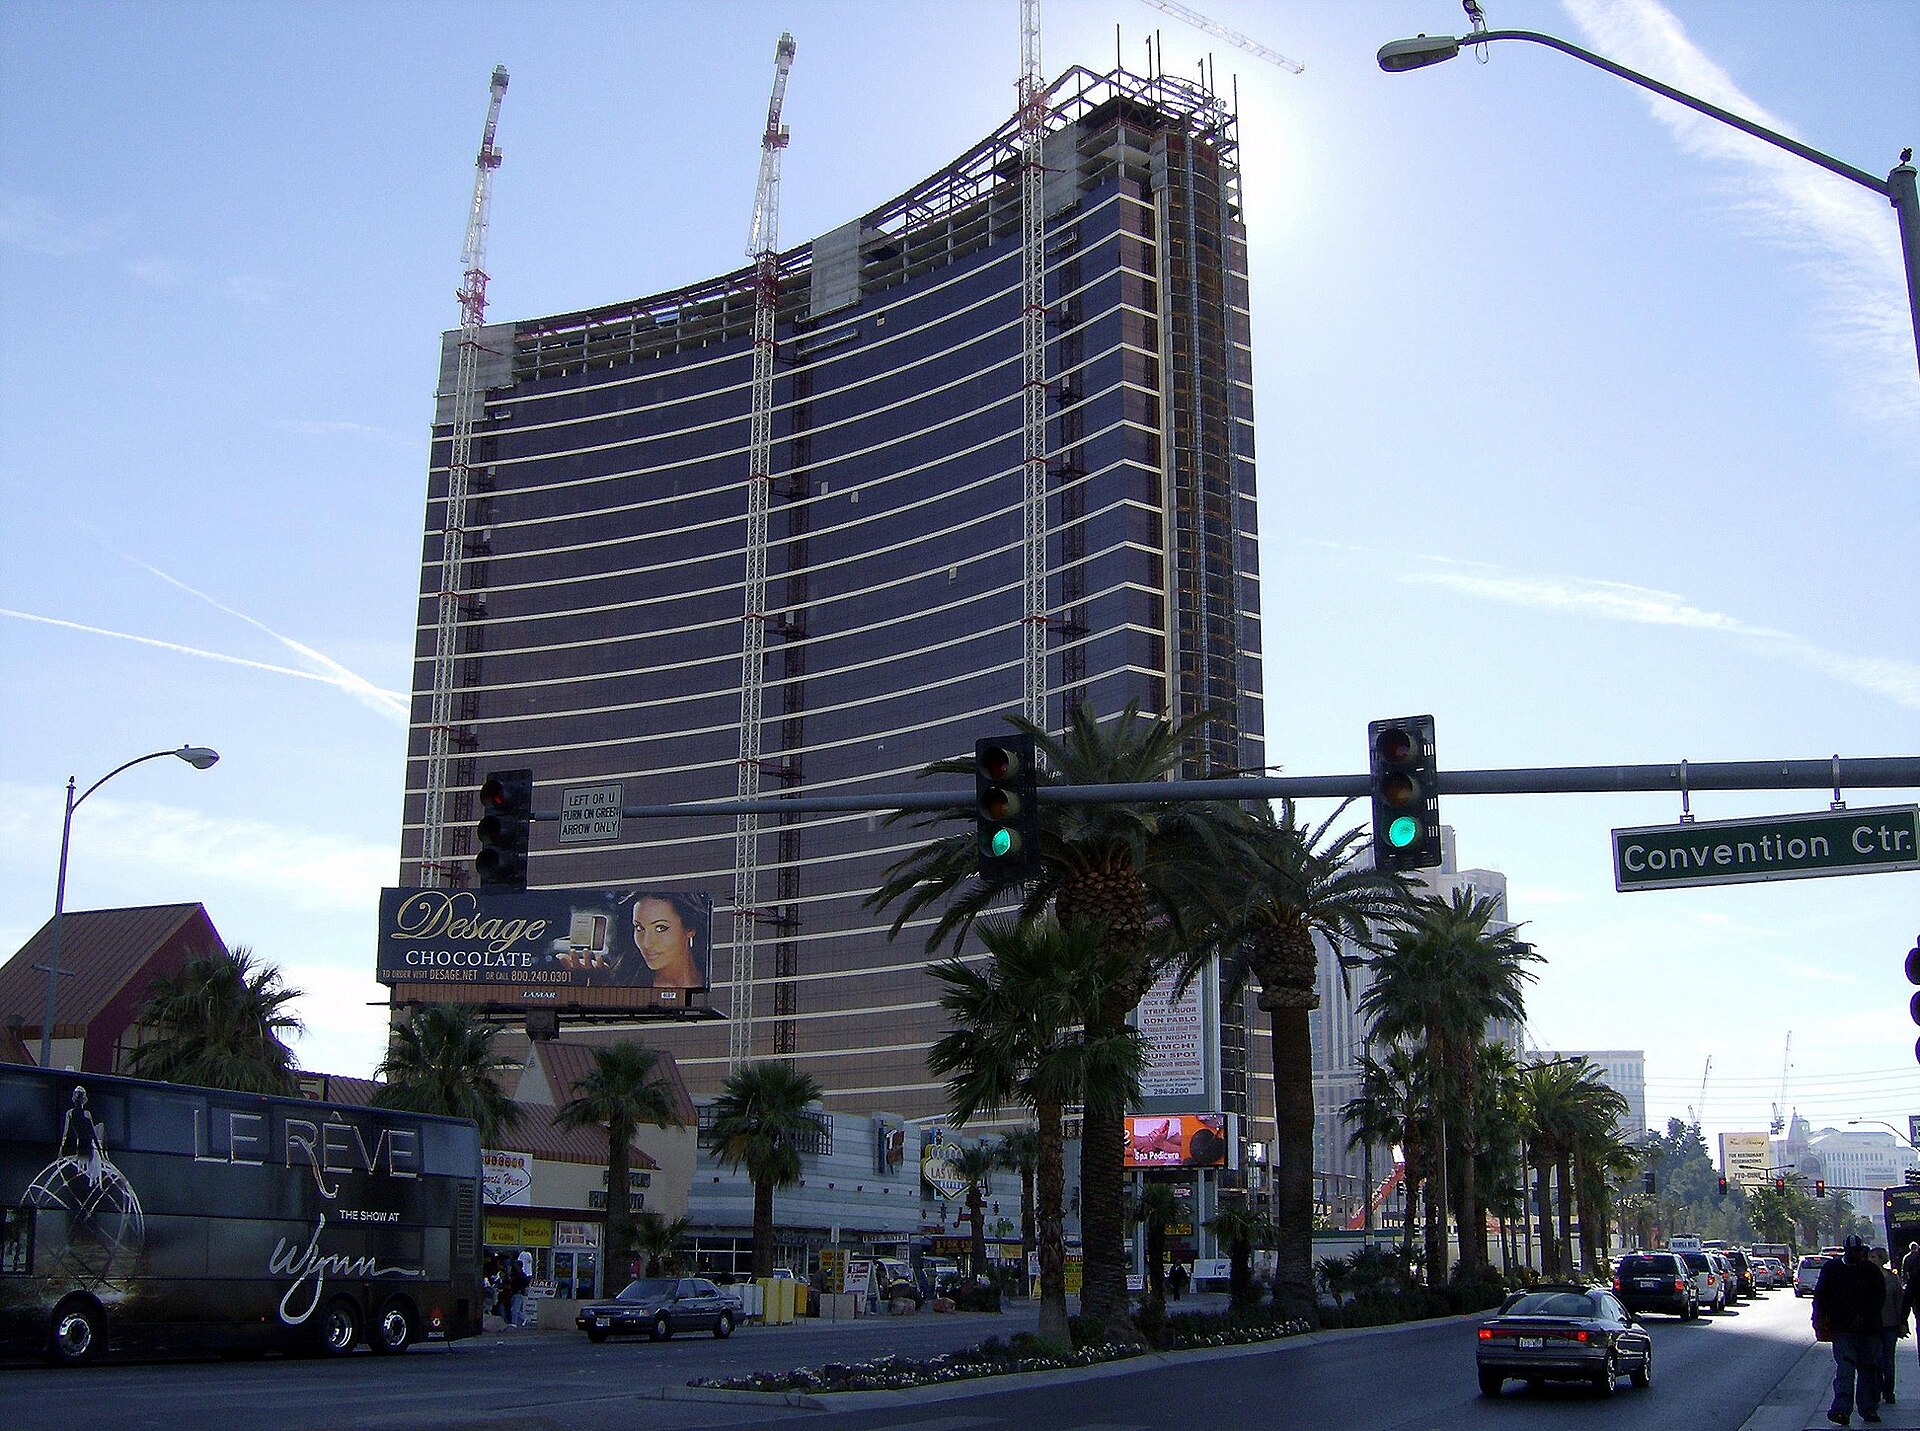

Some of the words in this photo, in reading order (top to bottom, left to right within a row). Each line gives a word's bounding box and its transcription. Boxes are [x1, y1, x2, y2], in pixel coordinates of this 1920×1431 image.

[569, 794, 590, 806] LEFT
[592, 793, 605, 804] OR
[608, 792, 615, 803] U
[584, 808, 595, 819] ON
[596, 807, 619, 818] GREEN
[562, 824, 591, 835] ARROW
[594, 821, 617, 833] ONLY
[1624, 834, 1829, 872] Convention
[1852, 825, 1911, 854] Ctr.
[391, 891, 545, 953] Desage
[405, 950, 532, 967] CHOCOLATE
[382, 969, 391, 979] TO
[429, 969, 478, 981] DESAGE.NET
[511, 970, 572, 983] 800.240.0301
[523, 991, 557, 999] LAMAR
[1166, 1015, 1197, 1023] PABLO
[194, 1109, 264, 1166] LE
[1134, 1151, 1148, 1161] Spa
[931, 1167, 945, 1179] LAS
[339, 1209, 358, 1221] THE
[360, 1210, 387, 1222] SHOW
[388, 1212, 401, 1222] AT
